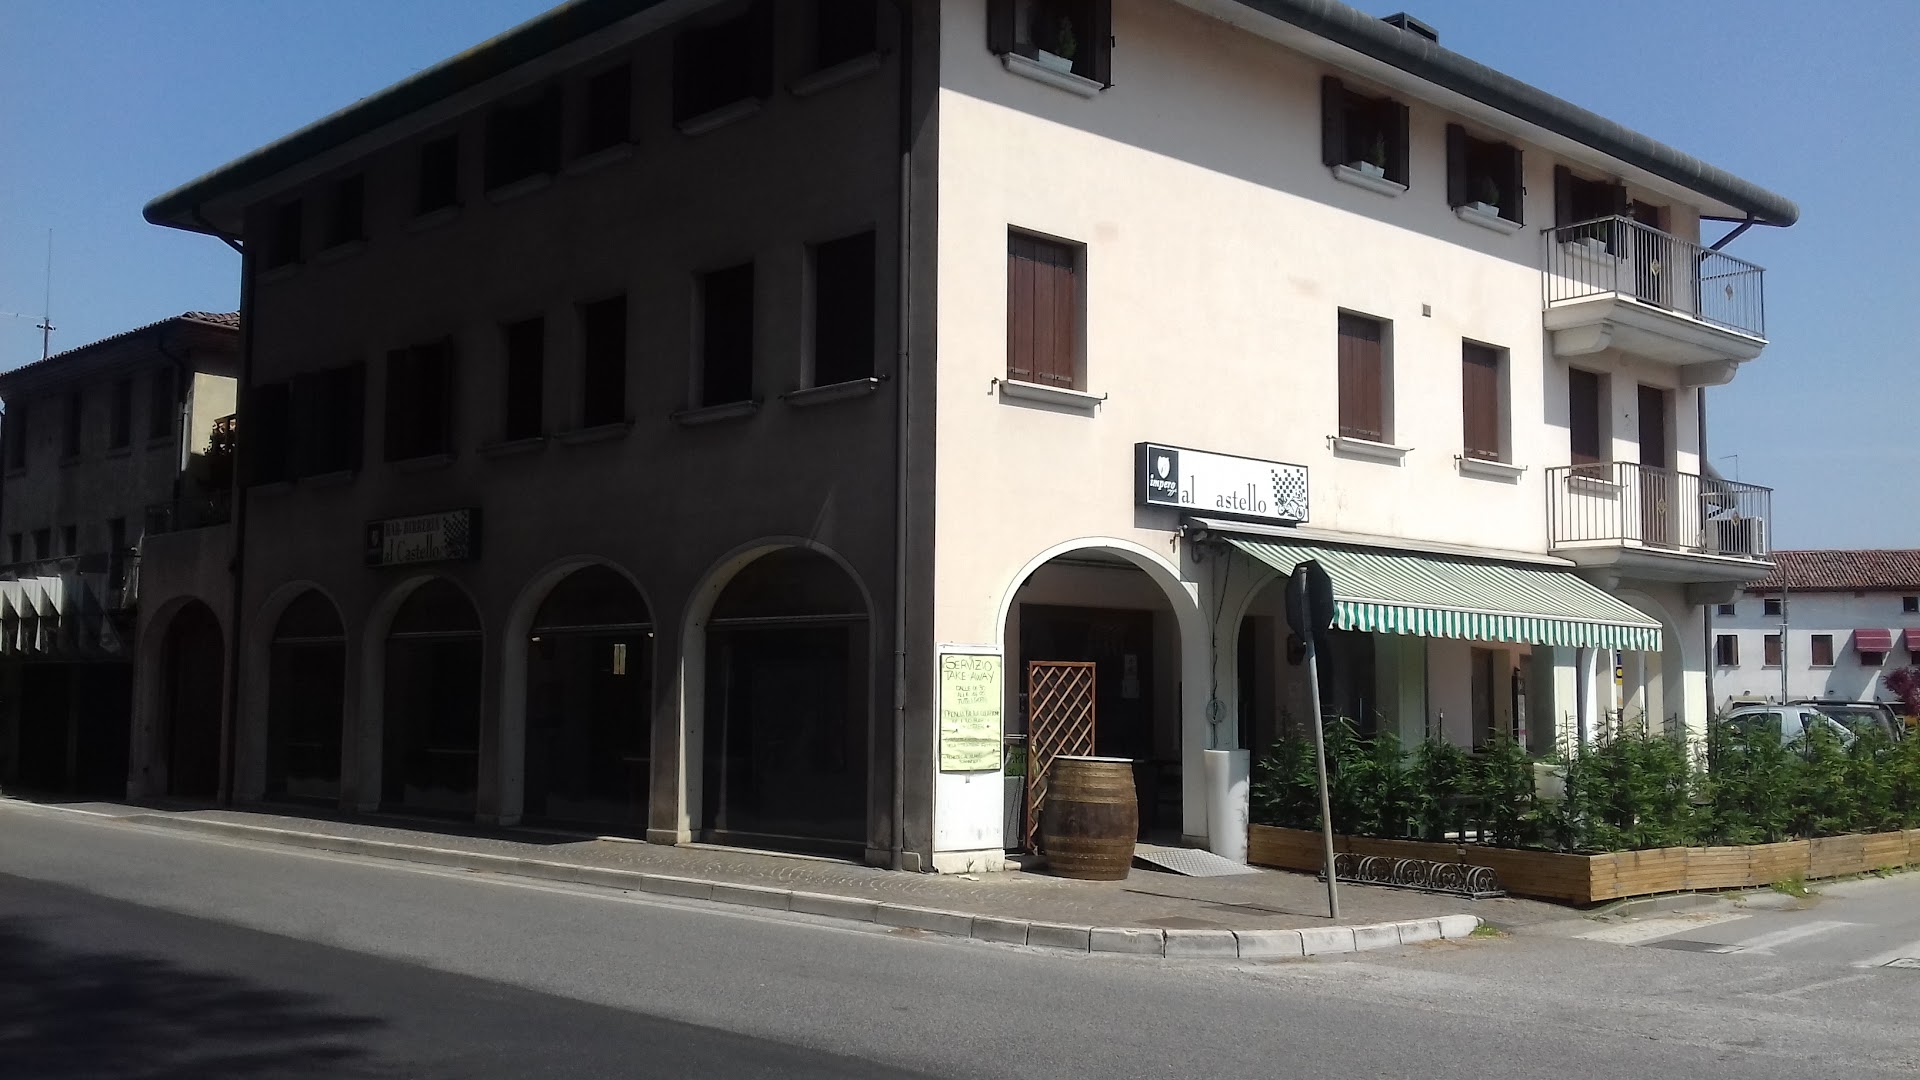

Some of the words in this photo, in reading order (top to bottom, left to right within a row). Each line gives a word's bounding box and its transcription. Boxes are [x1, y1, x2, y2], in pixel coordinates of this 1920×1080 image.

[1150, 474, 1176, 490] impero
[1181, 475, 1196, 504] al
[383, 539, 394, 560] al
[945, 656, 992, 671] SERVIZIO
[944, 670, 966, 681] TAKE
[970, 671, 994, 683] AWAY
